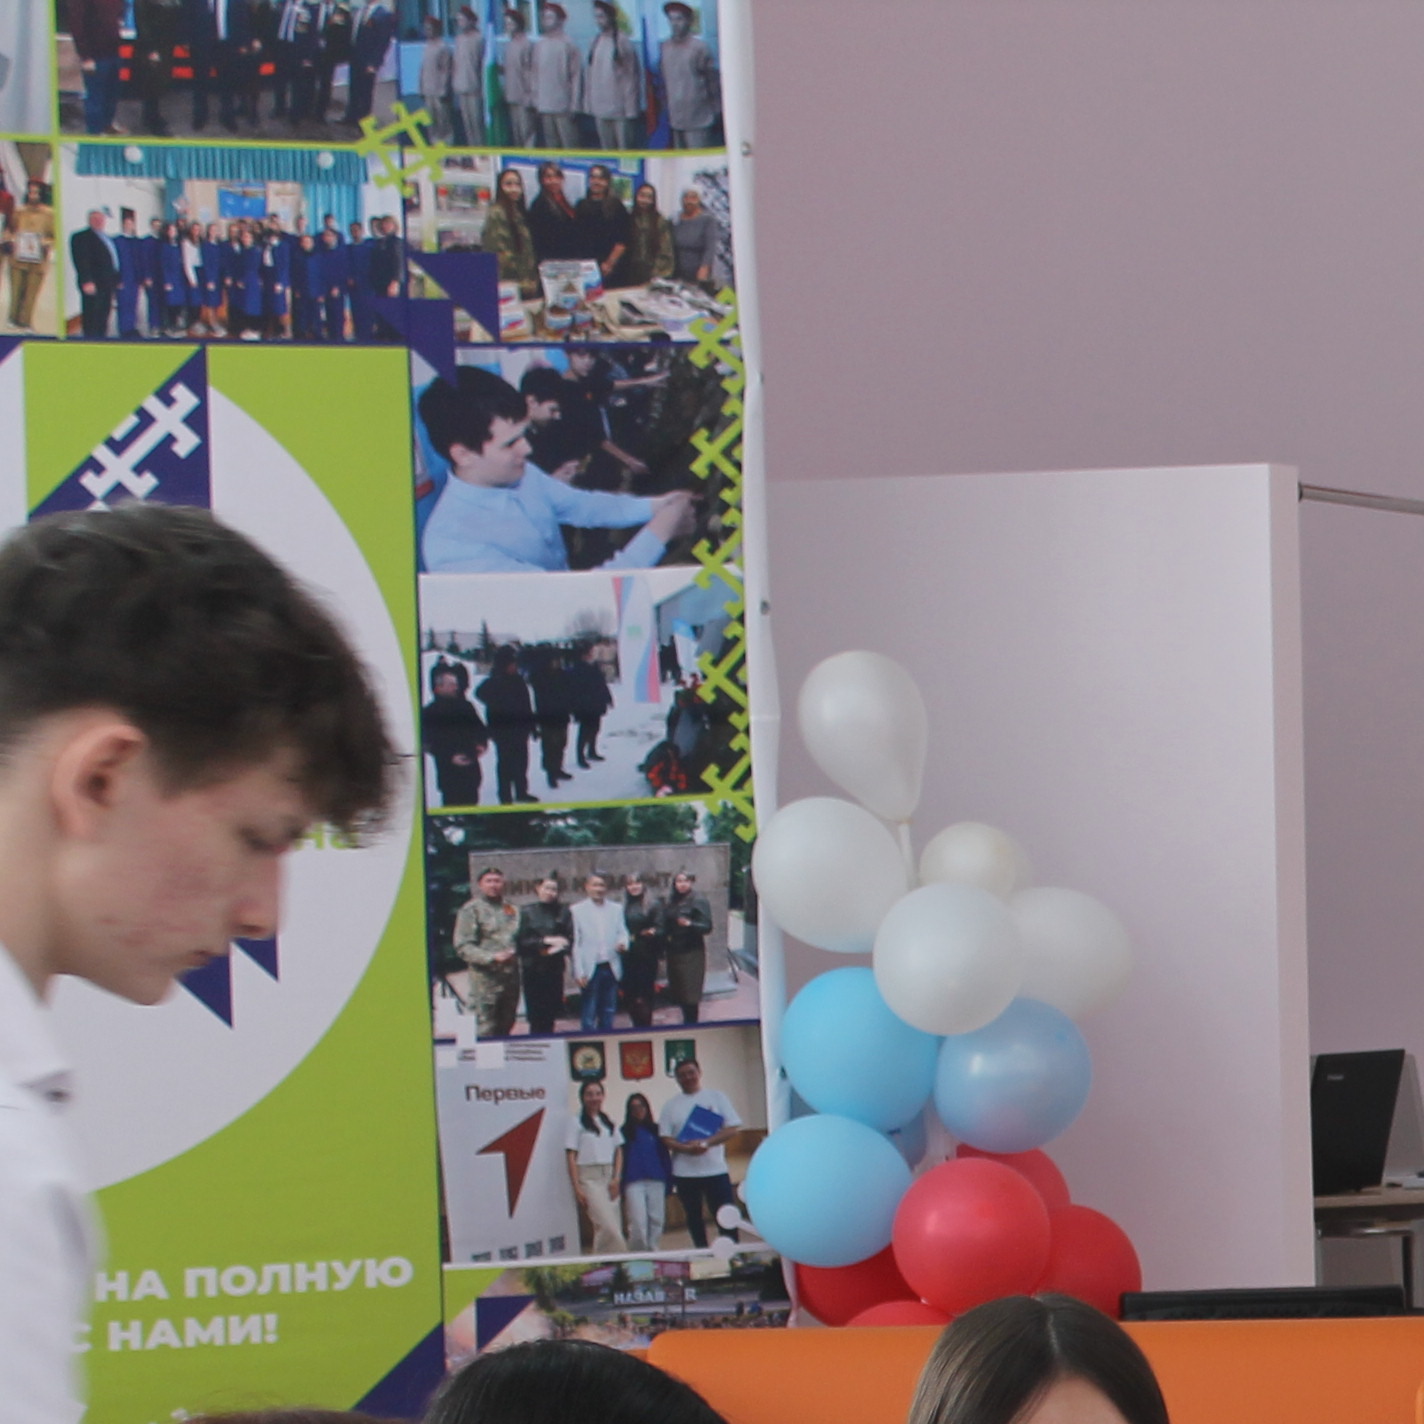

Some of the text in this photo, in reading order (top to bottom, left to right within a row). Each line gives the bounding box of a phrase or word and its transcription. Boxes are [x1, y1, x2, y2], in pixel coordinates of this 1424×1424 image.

[465, 1084, 546, 1104] Первые
[95, 1256, 414, 1301] НА ПОЛНУЮ
[107, 1313, 279, 1351] НАМИ!
